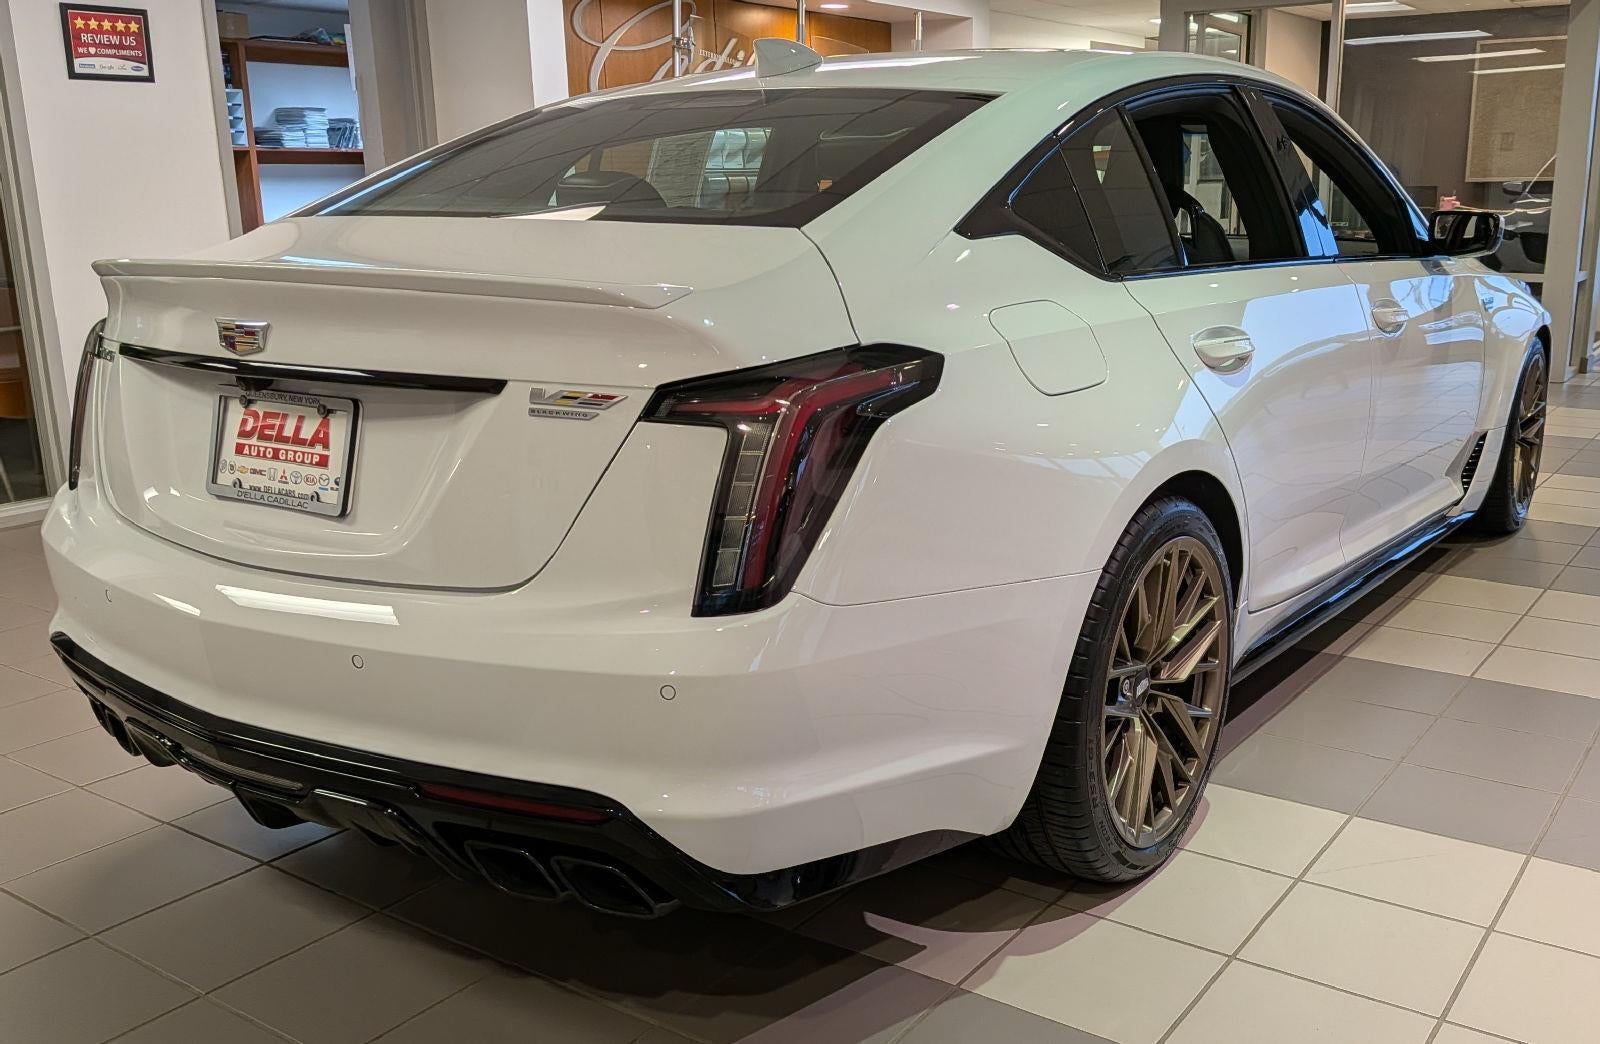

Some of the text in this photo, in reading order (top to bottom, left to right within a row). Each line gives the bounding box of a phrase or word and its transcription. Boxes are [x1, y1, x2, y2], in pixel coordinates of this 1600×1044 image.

[81, 33, 137, 46] REVIEW US
[97, 48, 143, 57] COMPLIMENTS
[289, 395, 304, 403] NEW
[304, 396, 320, 405] YORK
[530, 408, 588, 418] BLACKWING
[236, 408, 330, 451] DELLA
[243, 447, 320, 465] AUTO GROUP
[249, 468, 266, 477] GMC
[236, 490, 308, 509] D'ELLA CADILLAC
